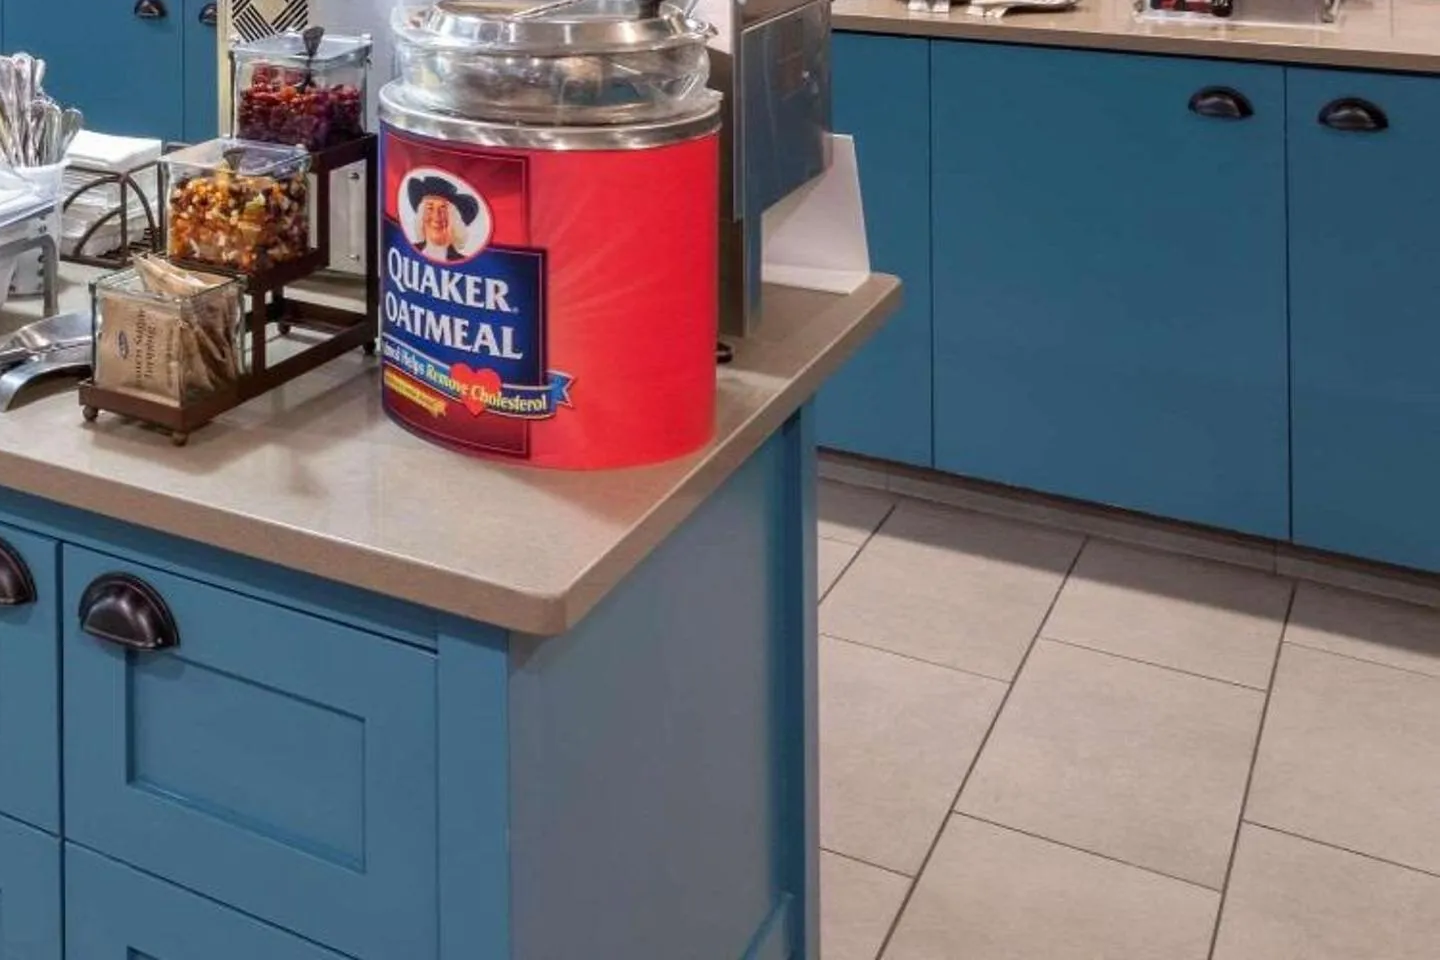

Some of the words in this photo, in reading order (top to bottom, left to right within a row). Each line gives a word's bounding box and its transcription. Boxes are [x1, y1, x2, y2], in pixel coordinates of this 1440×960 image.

[387, 247, 512, 313] QUAKER
[385, 291, 524, 360] OATMEAL
[426, 363, 470, 396] Remove
[470, 383, 548, 413] Cholesterol
